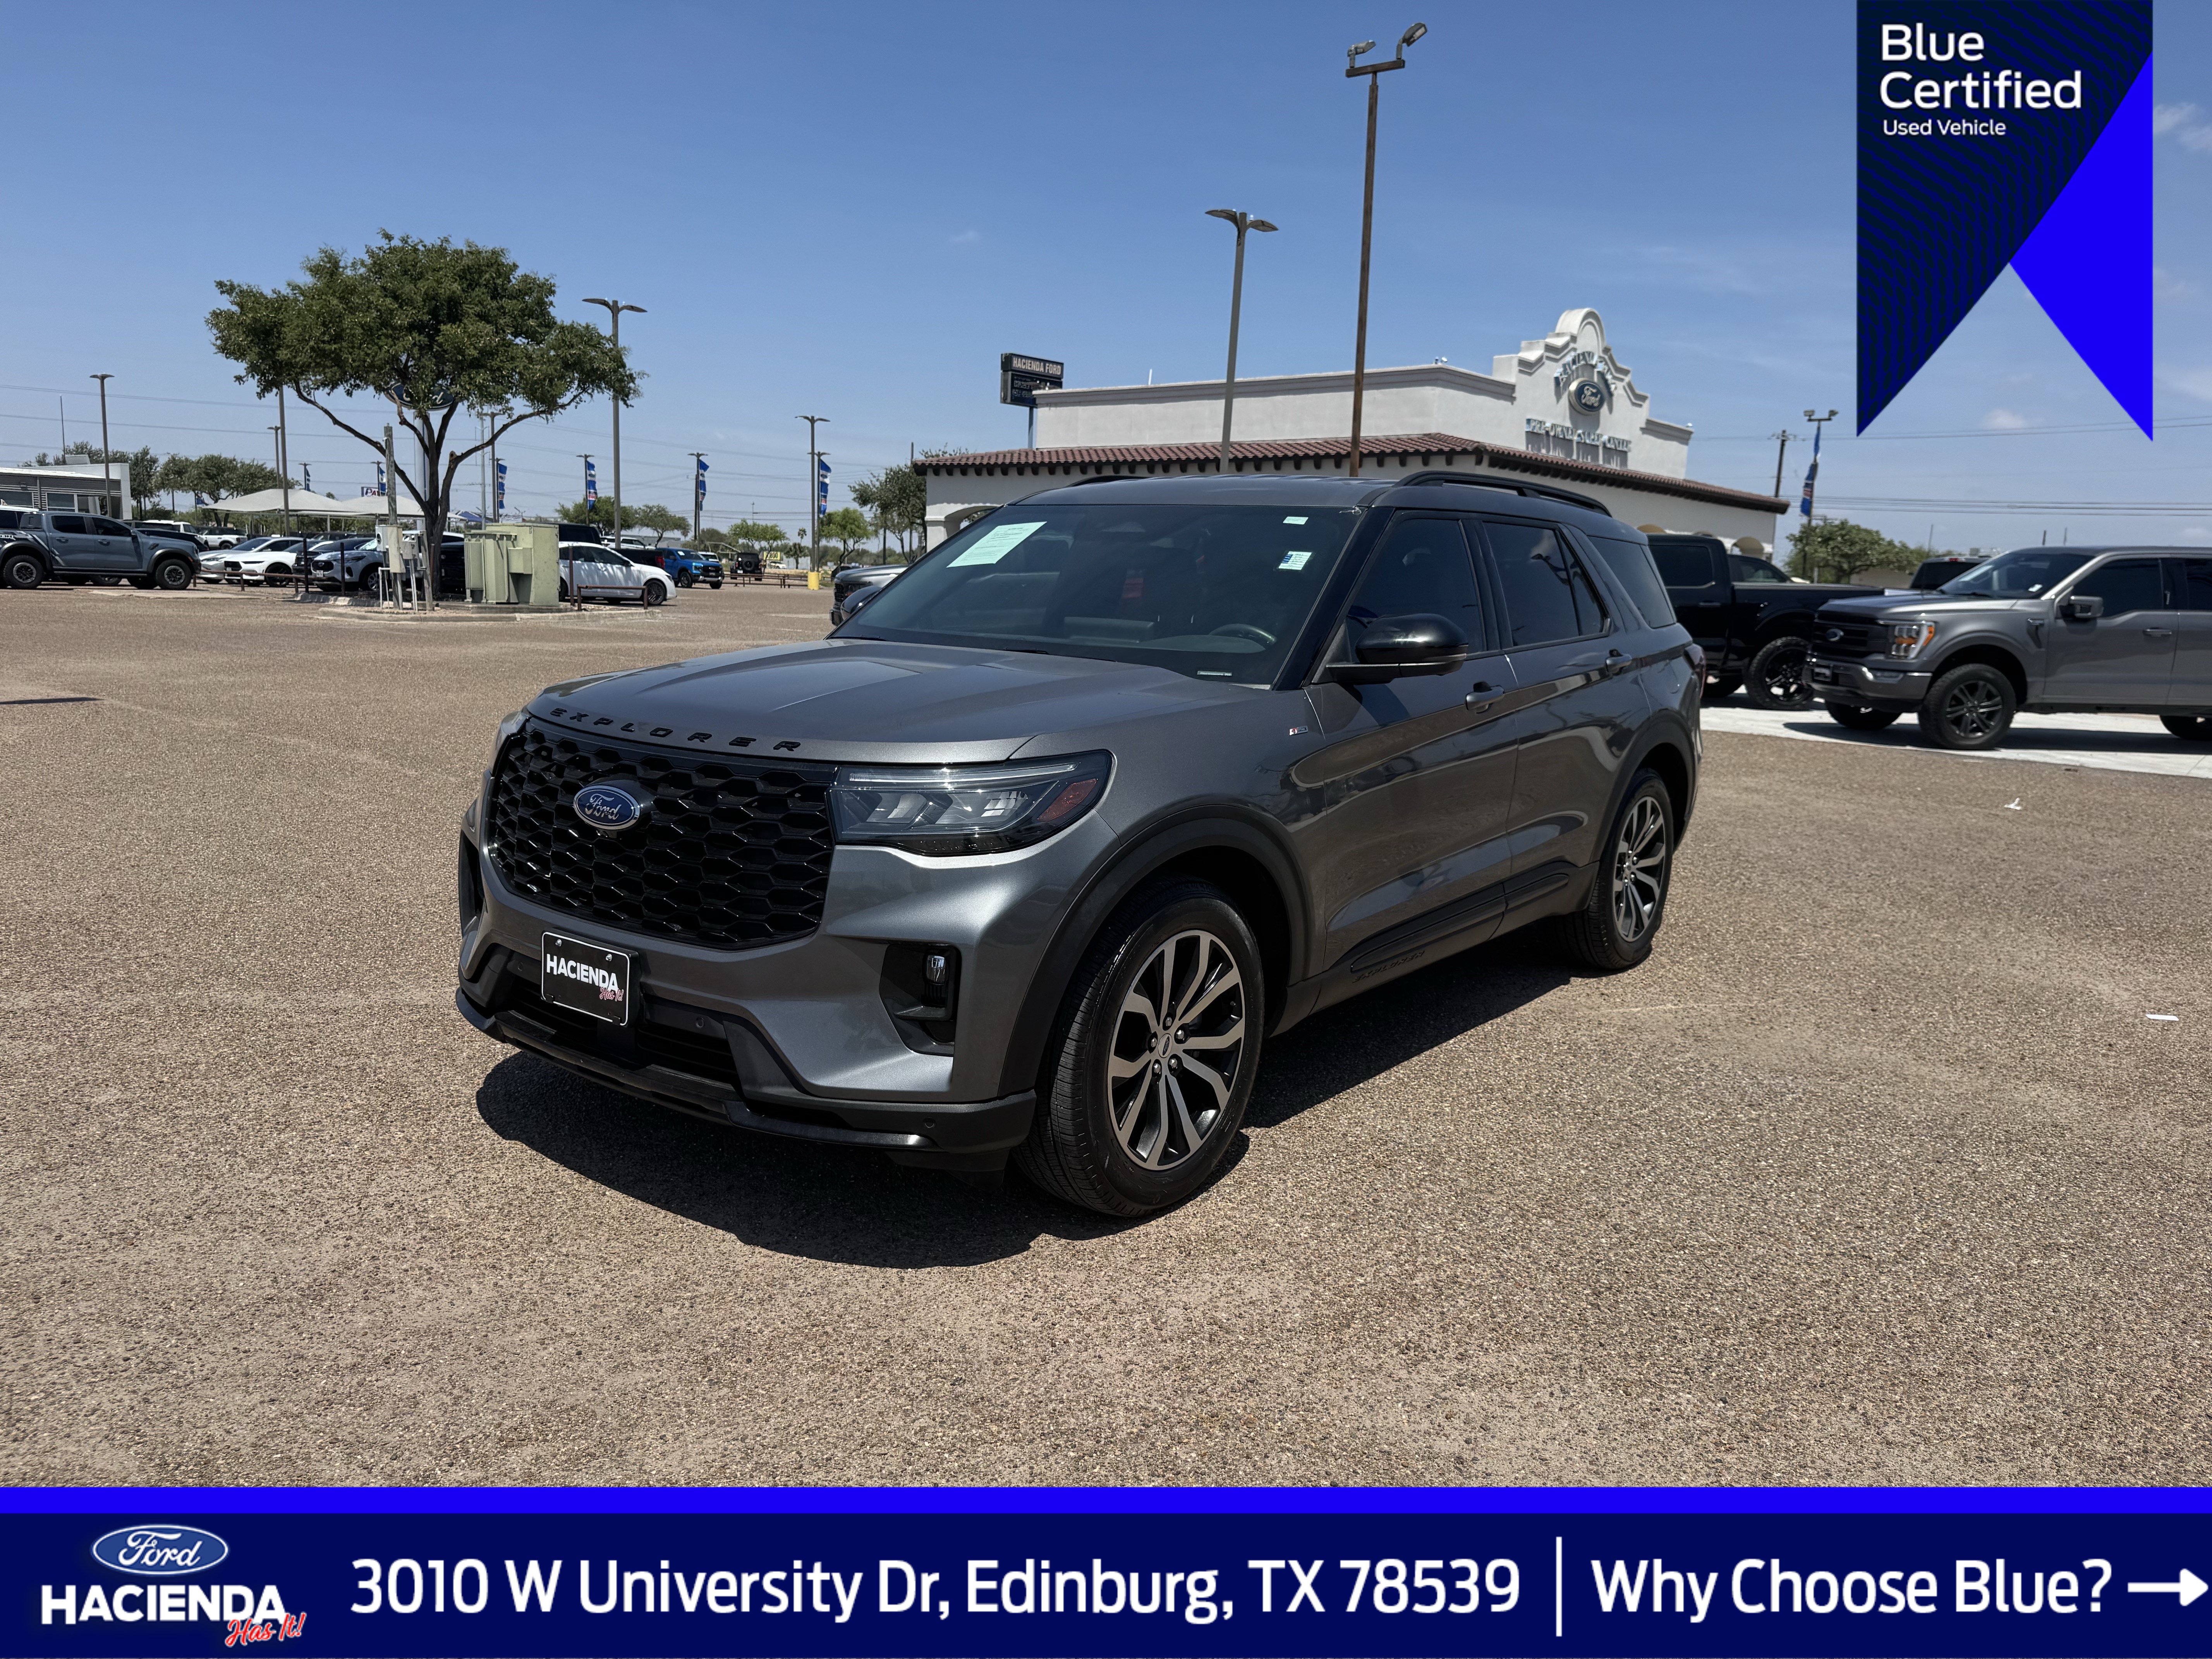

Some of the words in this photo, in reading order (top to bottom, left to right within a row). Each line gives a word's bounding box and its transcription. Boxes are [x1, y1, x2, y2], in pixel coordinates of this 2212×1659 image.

[1013, 357, 1044, 373] HACIENDA
[1046, 363, 1061, 375] FORD
[1581, 385, 1601, 407] Ford
[550, 707, 801, 752] EXPLORER
[585, 794, 622, 820] Ford
[546, 953, 618, 994] HACIENDA
